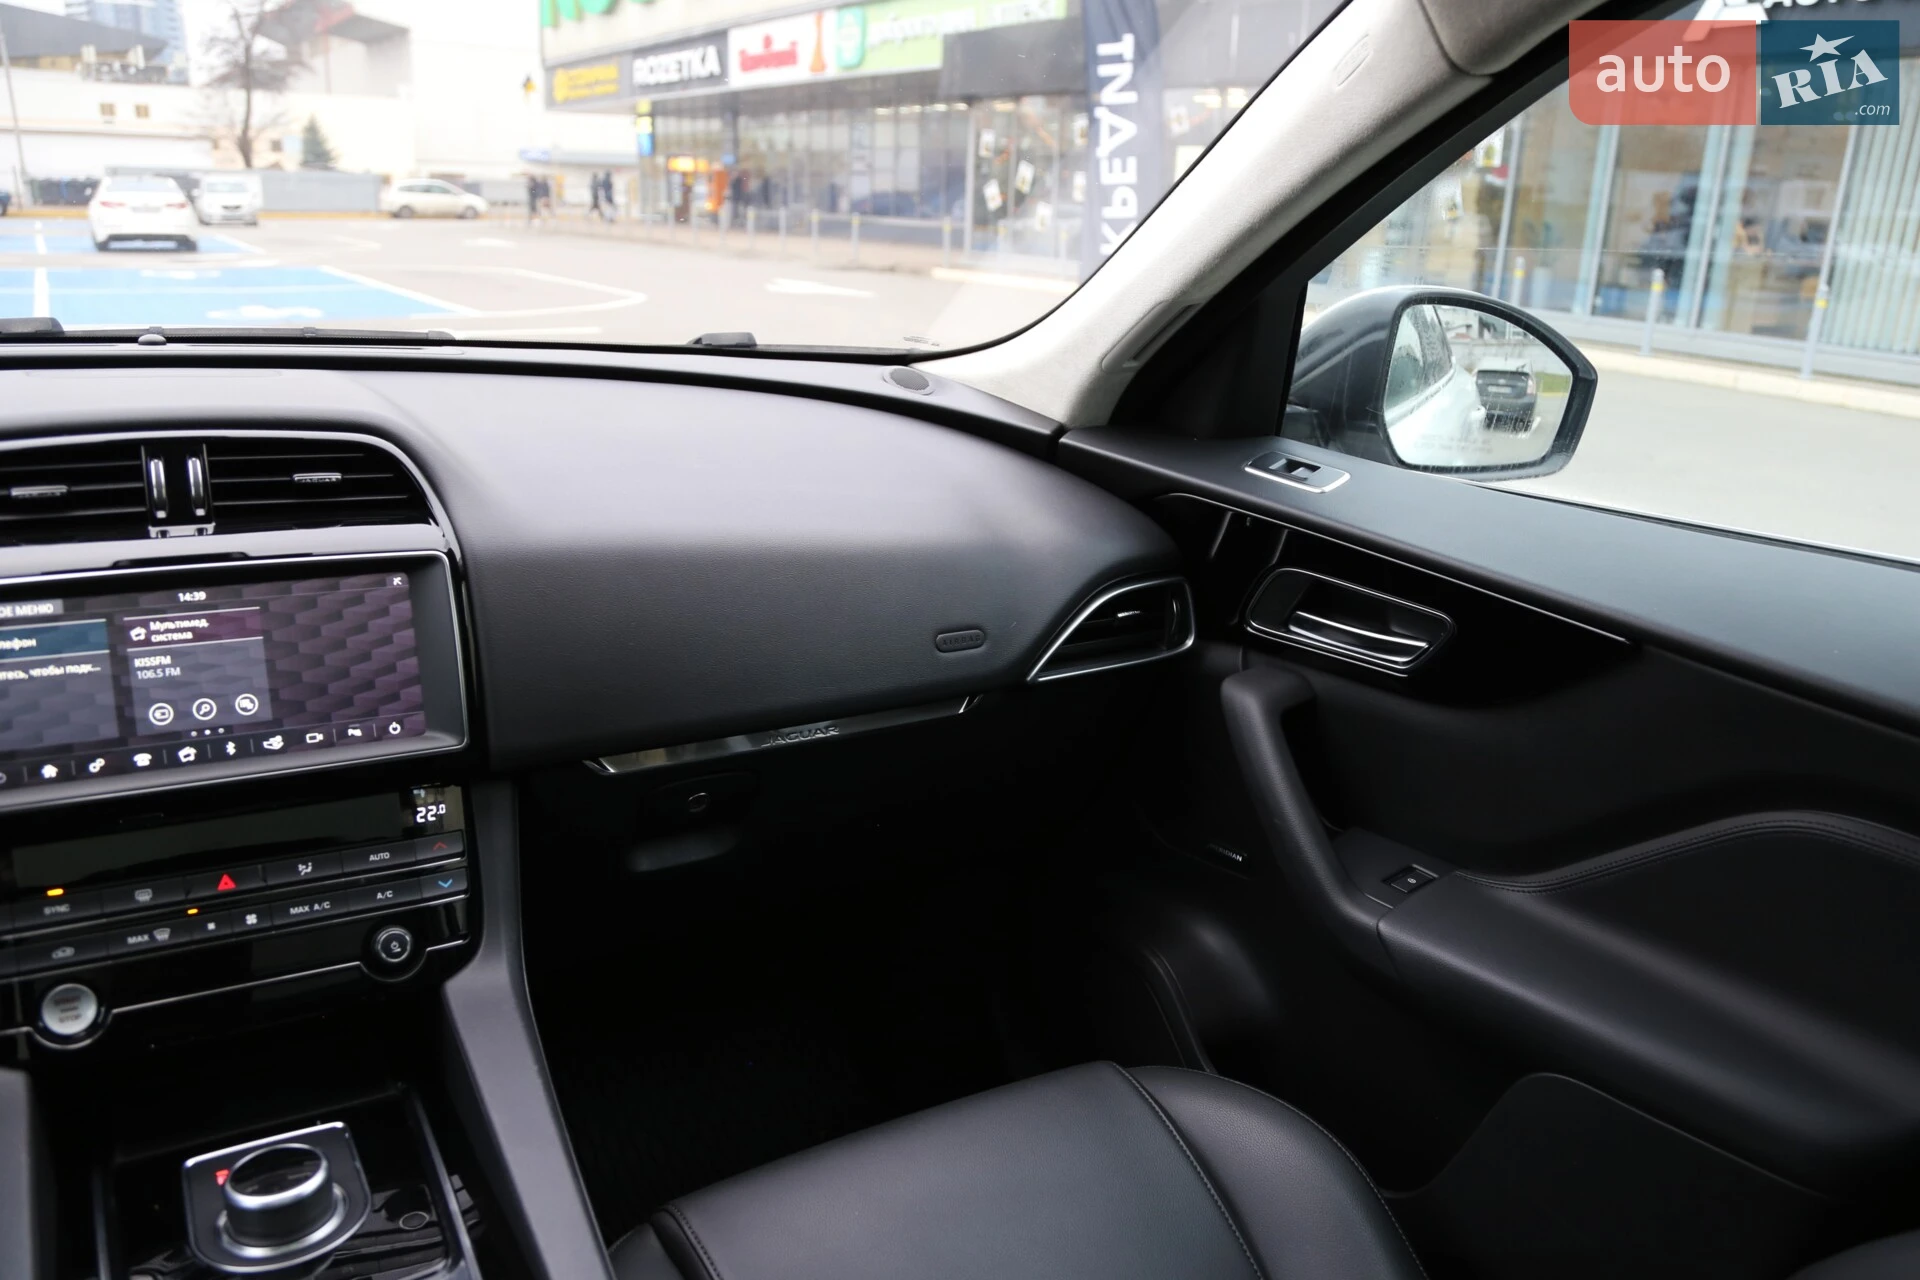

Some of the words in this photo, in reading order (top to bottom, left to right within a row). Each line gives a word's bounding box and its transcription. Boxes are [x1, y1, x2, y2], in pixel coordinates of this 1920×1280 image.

[178, 591, 207, 602] 14:39
[15, 603, 54, 615] МЕНЮ
[151, 631, 193, 642] система
[136, 667, 164, 680] 106.5
[165, 667, 181, 677] FM
[761, 727, 839, 747] JAGUAR
[369, 852, 390, 861] AUTO
[376, 890, 393, 899] A/C
[43, 903, 71, 915] SYNC
[289, 906, 311, 915] MAX
[313, 901, 332, 911] A/C
[126, 933, 150, 945] MAX
